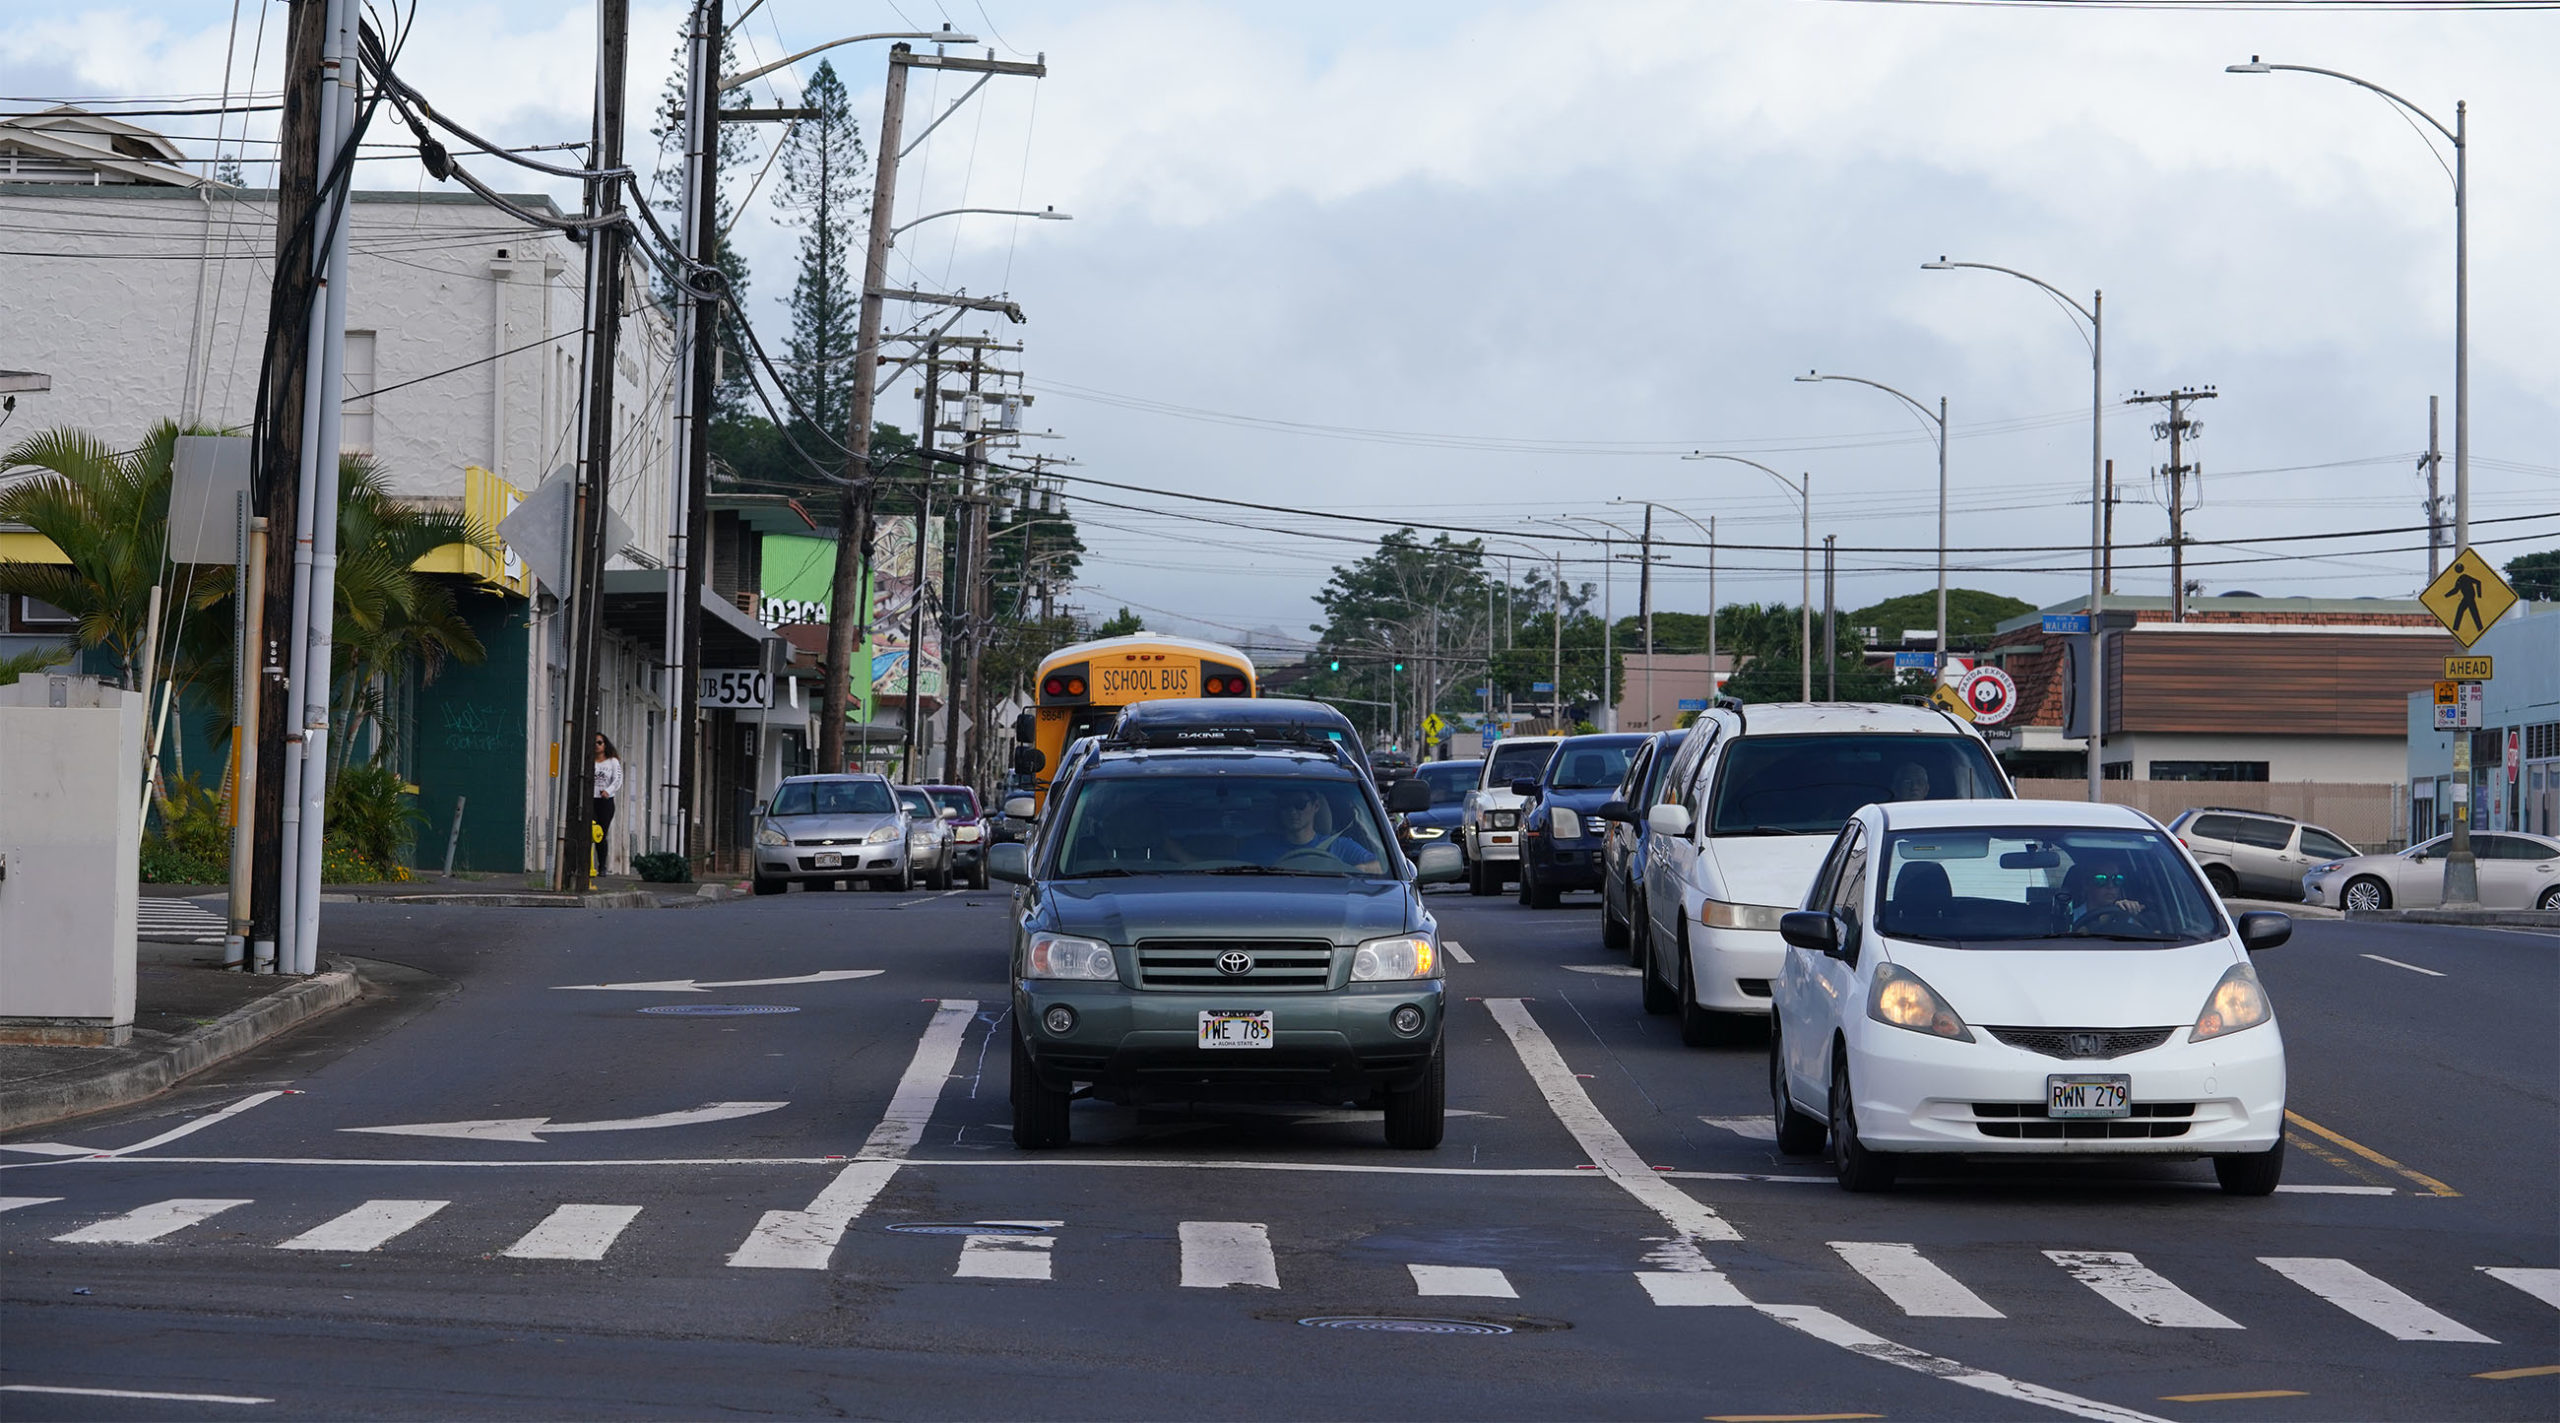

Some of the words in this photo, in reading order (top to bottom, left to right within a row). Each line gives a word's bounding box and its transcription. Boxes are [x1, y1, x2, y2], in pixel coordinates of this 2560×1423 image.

[760, 590, 827, 630] pace
[2045, 621, 2079, 631] WALKER
[2450, 661, 2487, 675] AHEAD
[699, 678, 718, 698] UB
[719, 672, 767, 704] 550
[1104, 669, 1157, 691] SCHOOL
[1161, 669, 1188, 691] BUS
[1961, 670, 1983, 693] PANDA
[1984, 668, 2014, 693] EXPRESS
[1988, 702, 2013, 721] KITCHEN
[1485, 727, 1493, 736] H
[1988, 730, 2011, 738] THRU
[2507, 749, 2519, 767] STOP
[1202, 1020, 1231, 1039] TWE
[1241, 1020, 1269, 1039] 785
[2053, 1086, 2085, 1107] RWN
[2095, 1086, 2126, 1107] 279
